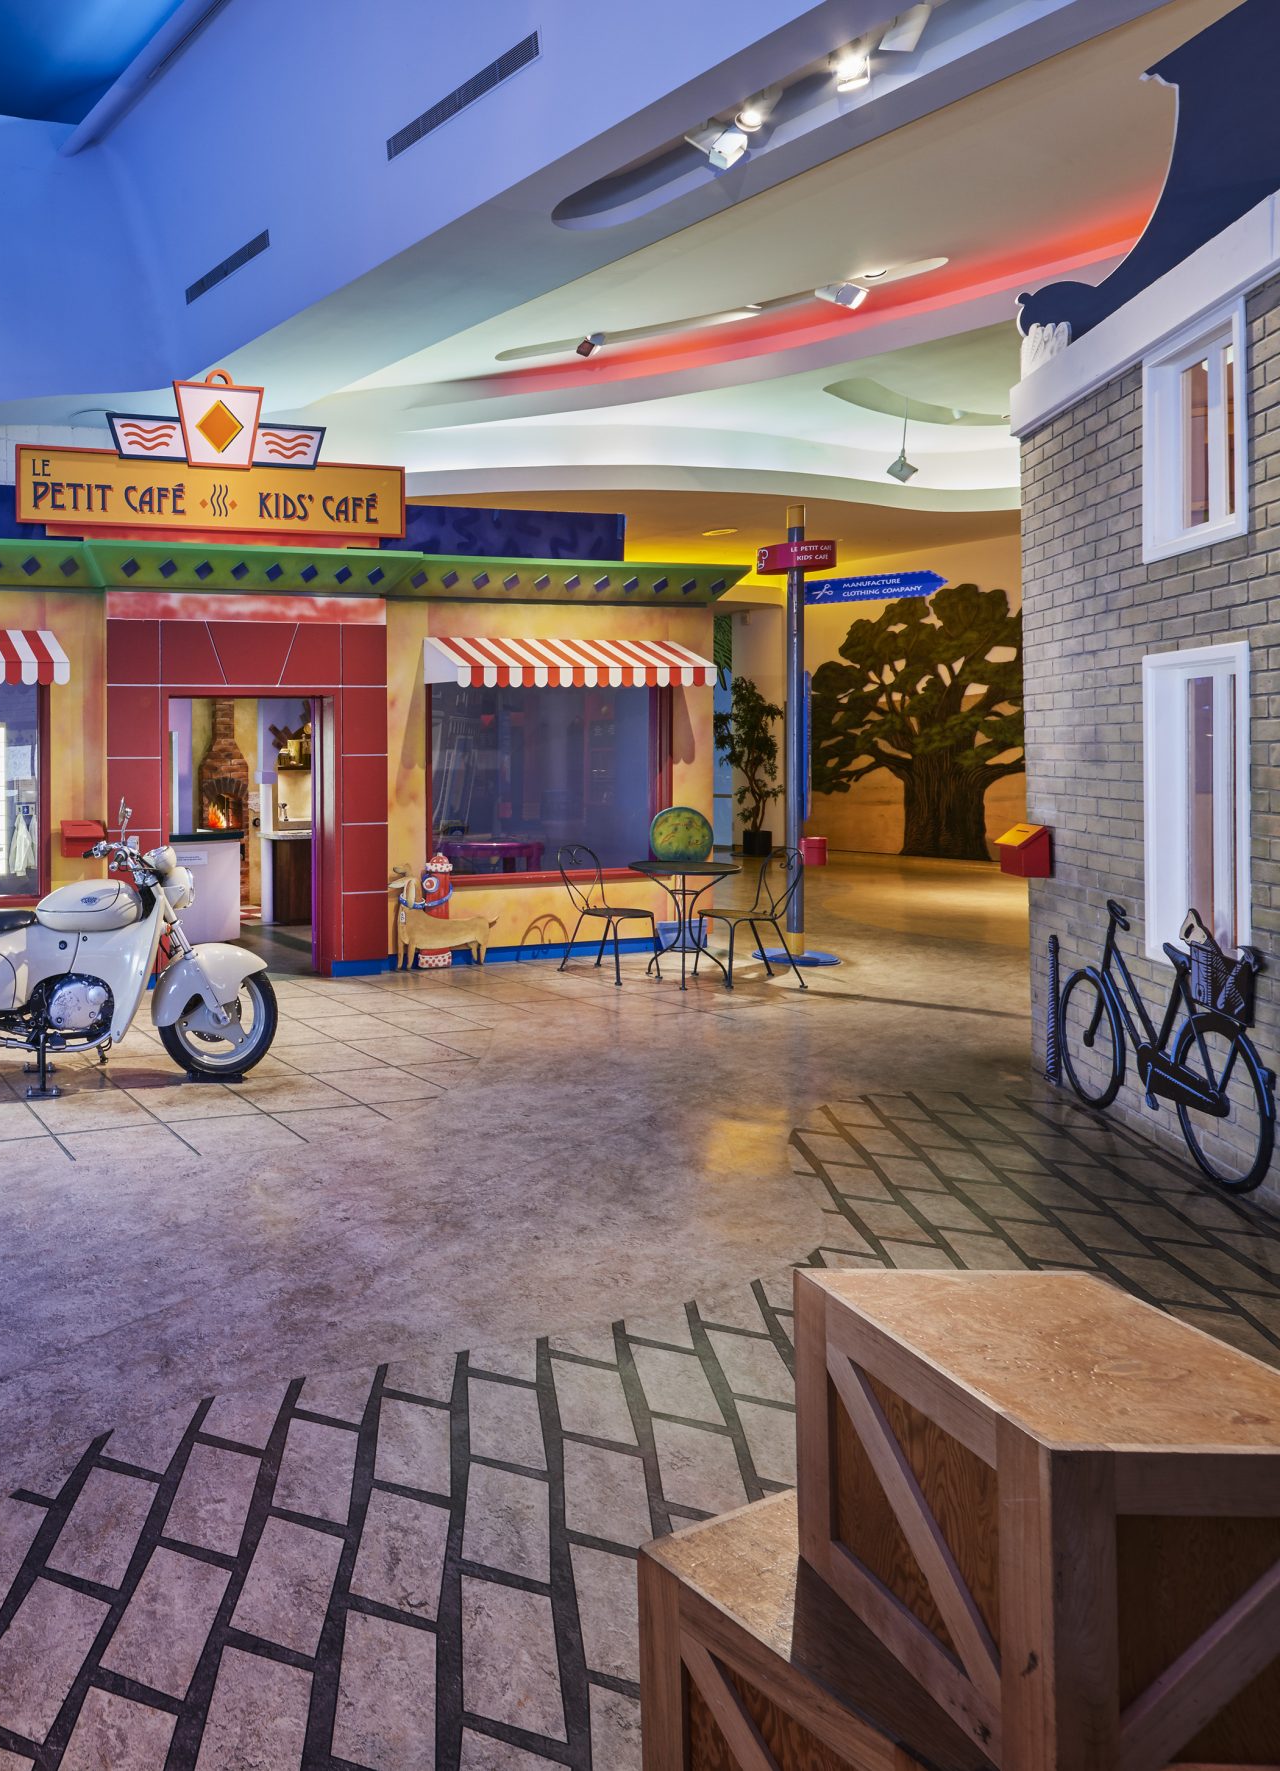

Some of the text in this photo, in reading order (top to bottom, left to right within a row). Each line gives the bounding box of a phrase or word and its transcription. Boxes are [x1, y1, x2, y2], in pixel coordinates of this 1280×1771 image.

[32, 459, 51, 477] LE
[32, 481, 378, 523] PETIT CAFÉ KIDS' CAFÉ
[842, 578, 901, 588] MANUFACTURE
[842, 585, 922, 597] CLOTHING COMPANY
